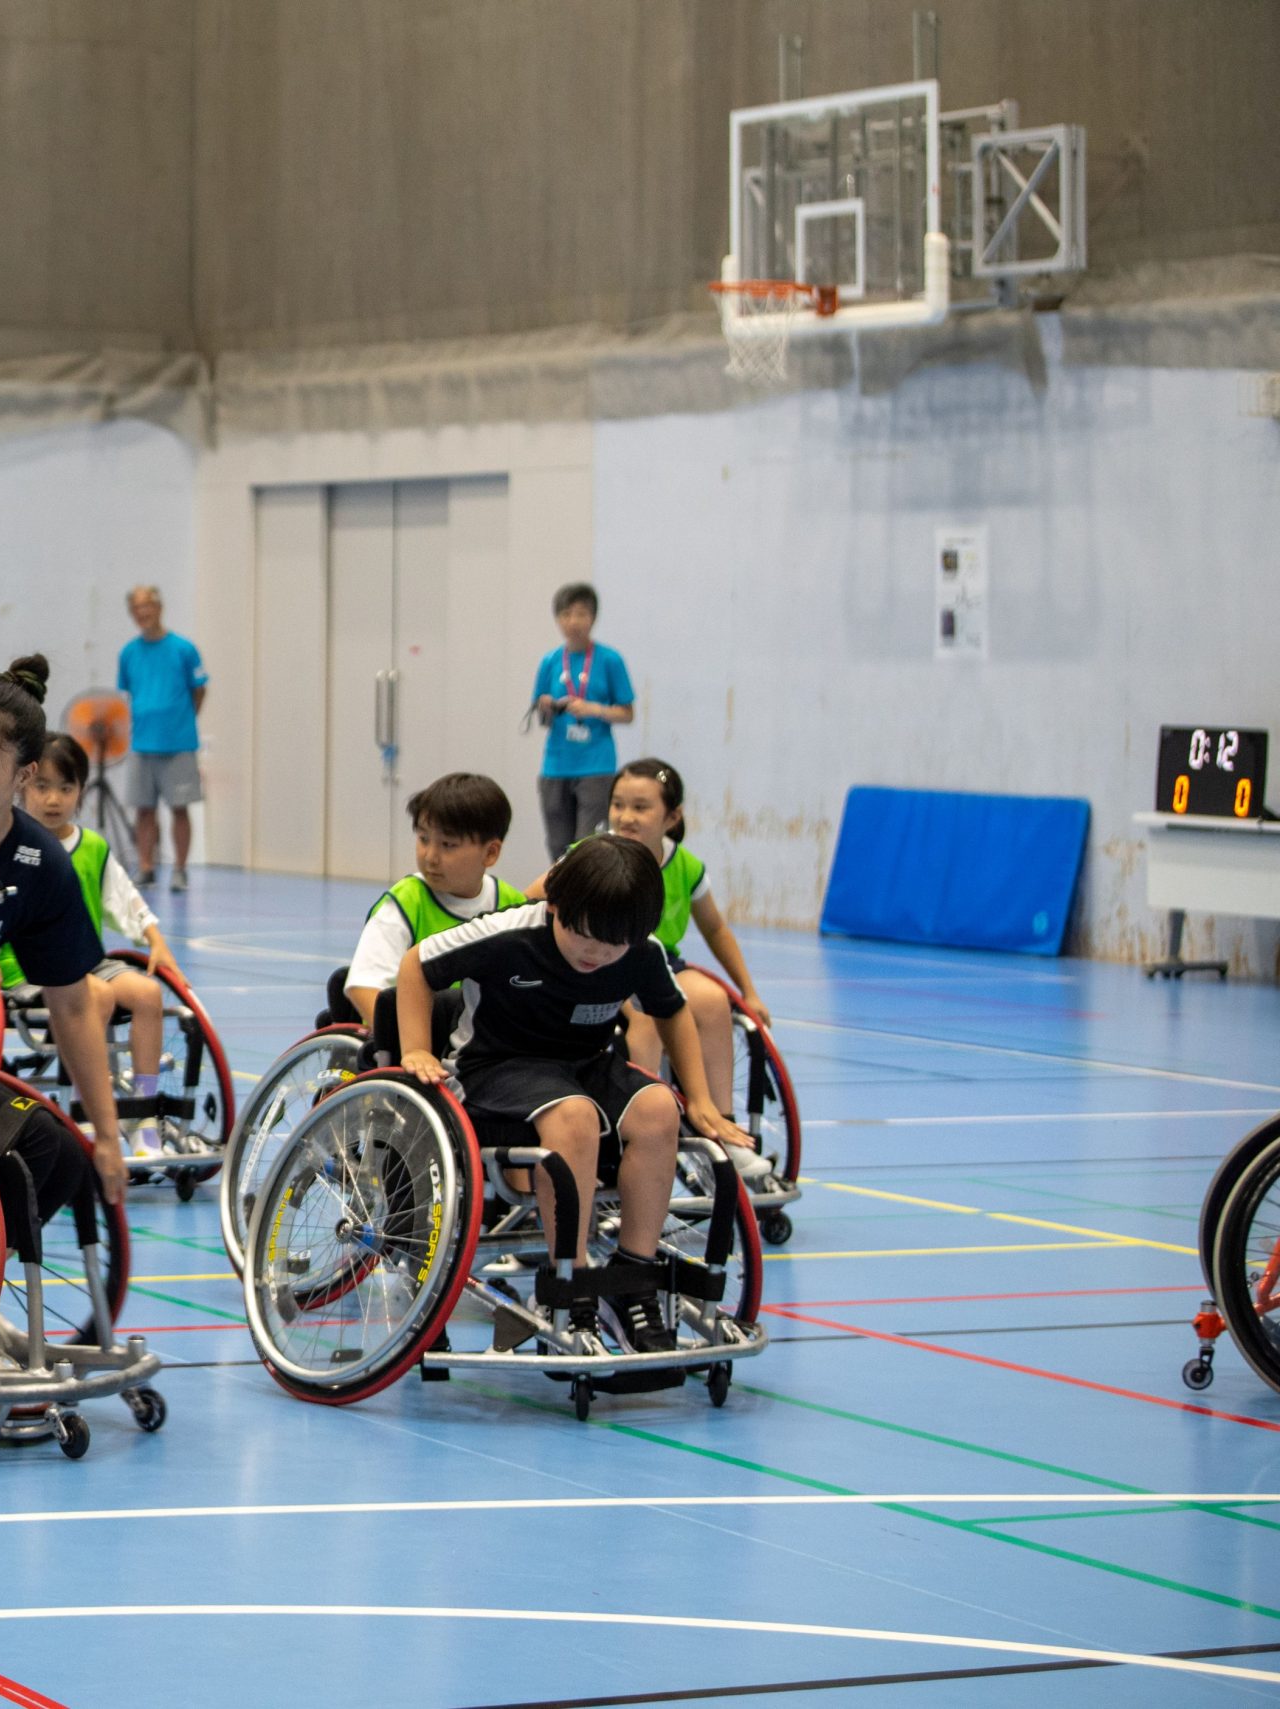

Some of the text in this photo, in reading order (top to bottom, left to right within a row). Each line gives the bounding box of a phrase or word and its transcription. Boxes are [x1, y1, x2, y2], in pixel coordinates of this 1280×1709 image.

[1189, 729, 1239, 771] 0:12
[1173, 774, 1252, 818] 0 0
[418, 1203, 443, 1283] SPORTS
